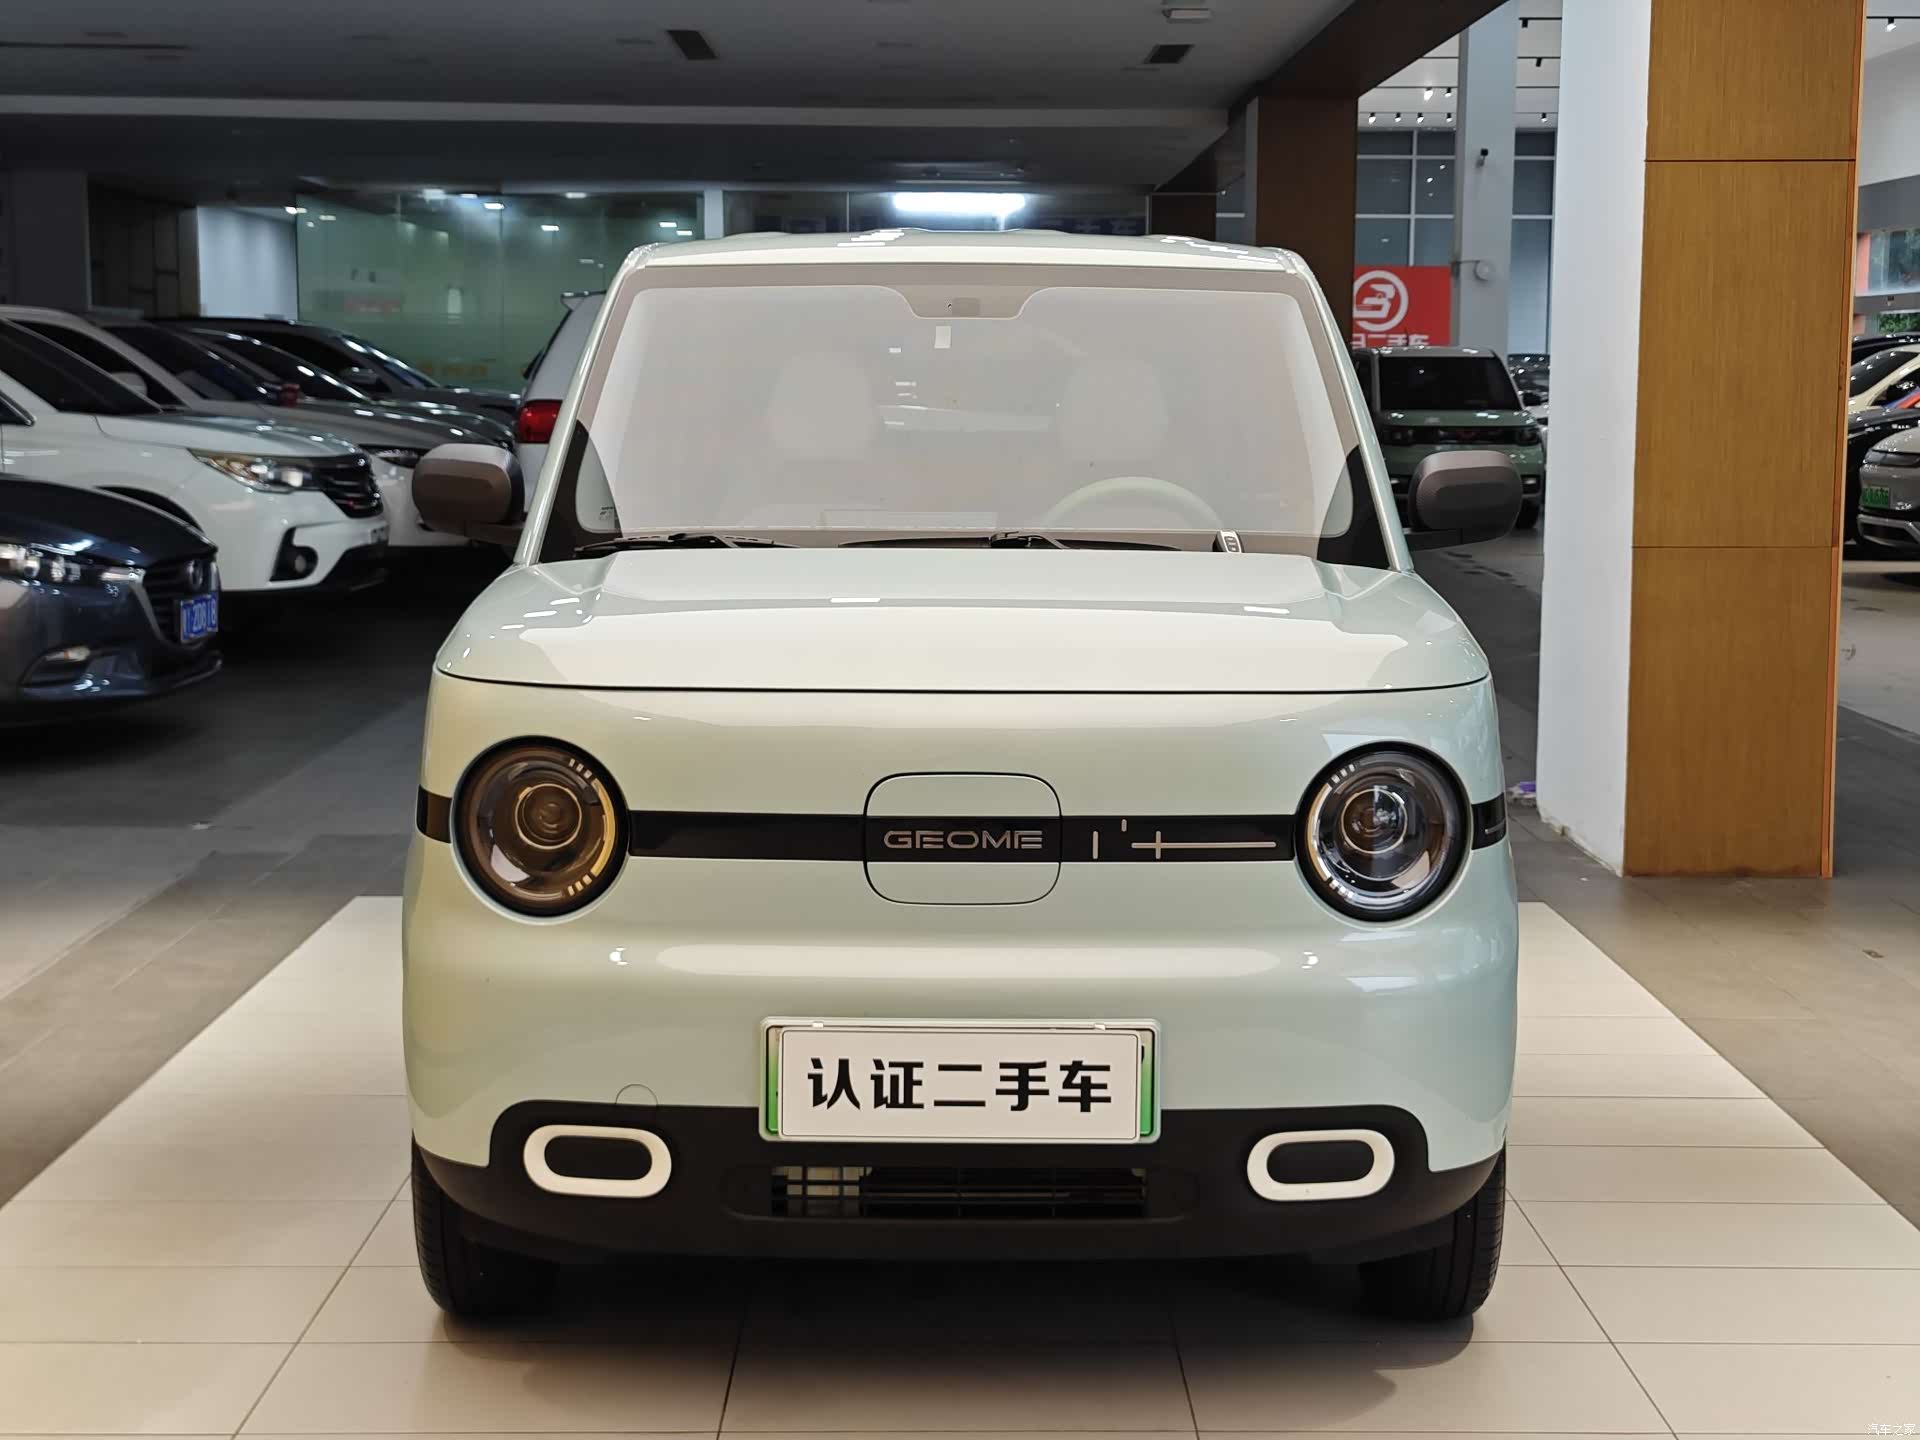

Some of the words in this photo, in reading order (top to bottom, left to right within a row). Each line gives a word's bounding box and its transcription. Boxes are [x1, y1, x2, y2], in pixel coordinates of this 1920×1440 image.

[883, 831, 1043, 849] GEOME
[807, 1057, 1112, 1113] 认证二手车
